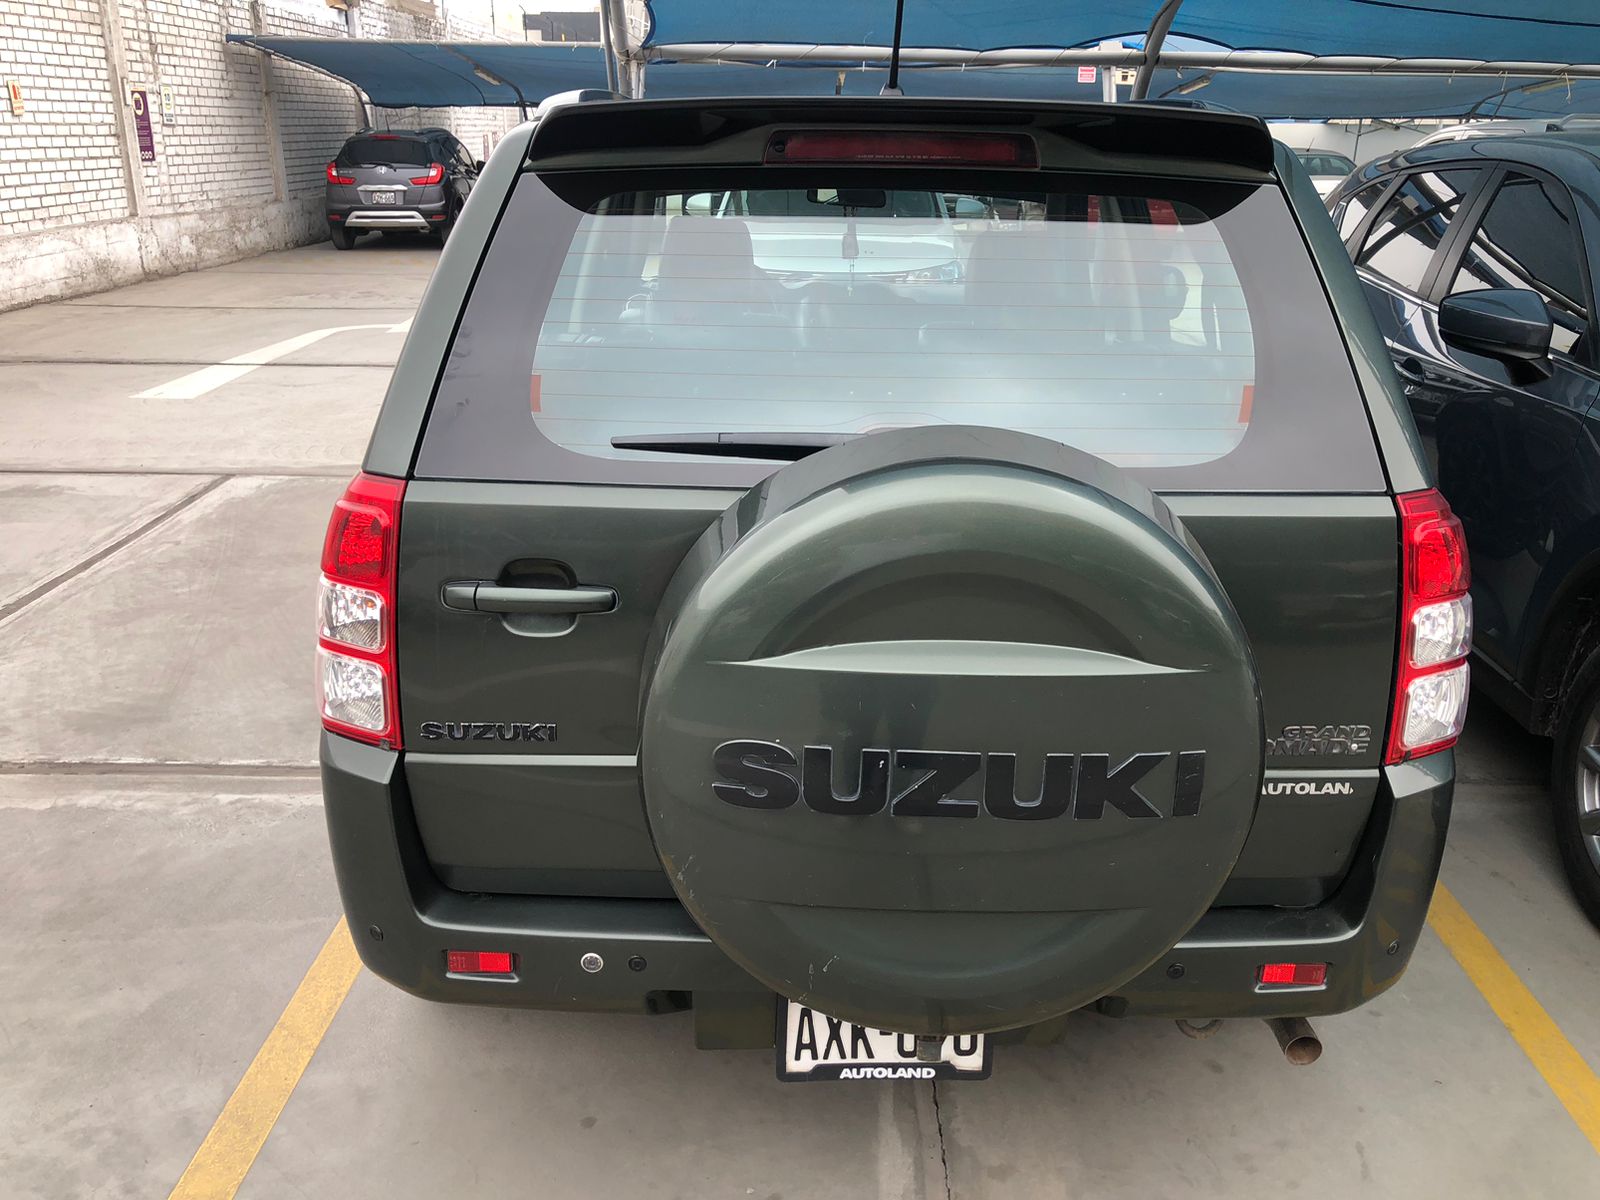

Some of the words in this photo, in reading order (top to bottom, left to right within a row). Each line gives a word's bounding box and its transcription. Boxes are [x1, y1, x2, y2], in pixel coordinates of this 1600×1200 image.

[420, 721, 558, 742] SUZUKI
[1282, 725, 1372, 738] GRAND
[712, 739, 1207, 821] SUZUKI
[839, 1066, 936, 1080] AUTOLAND
